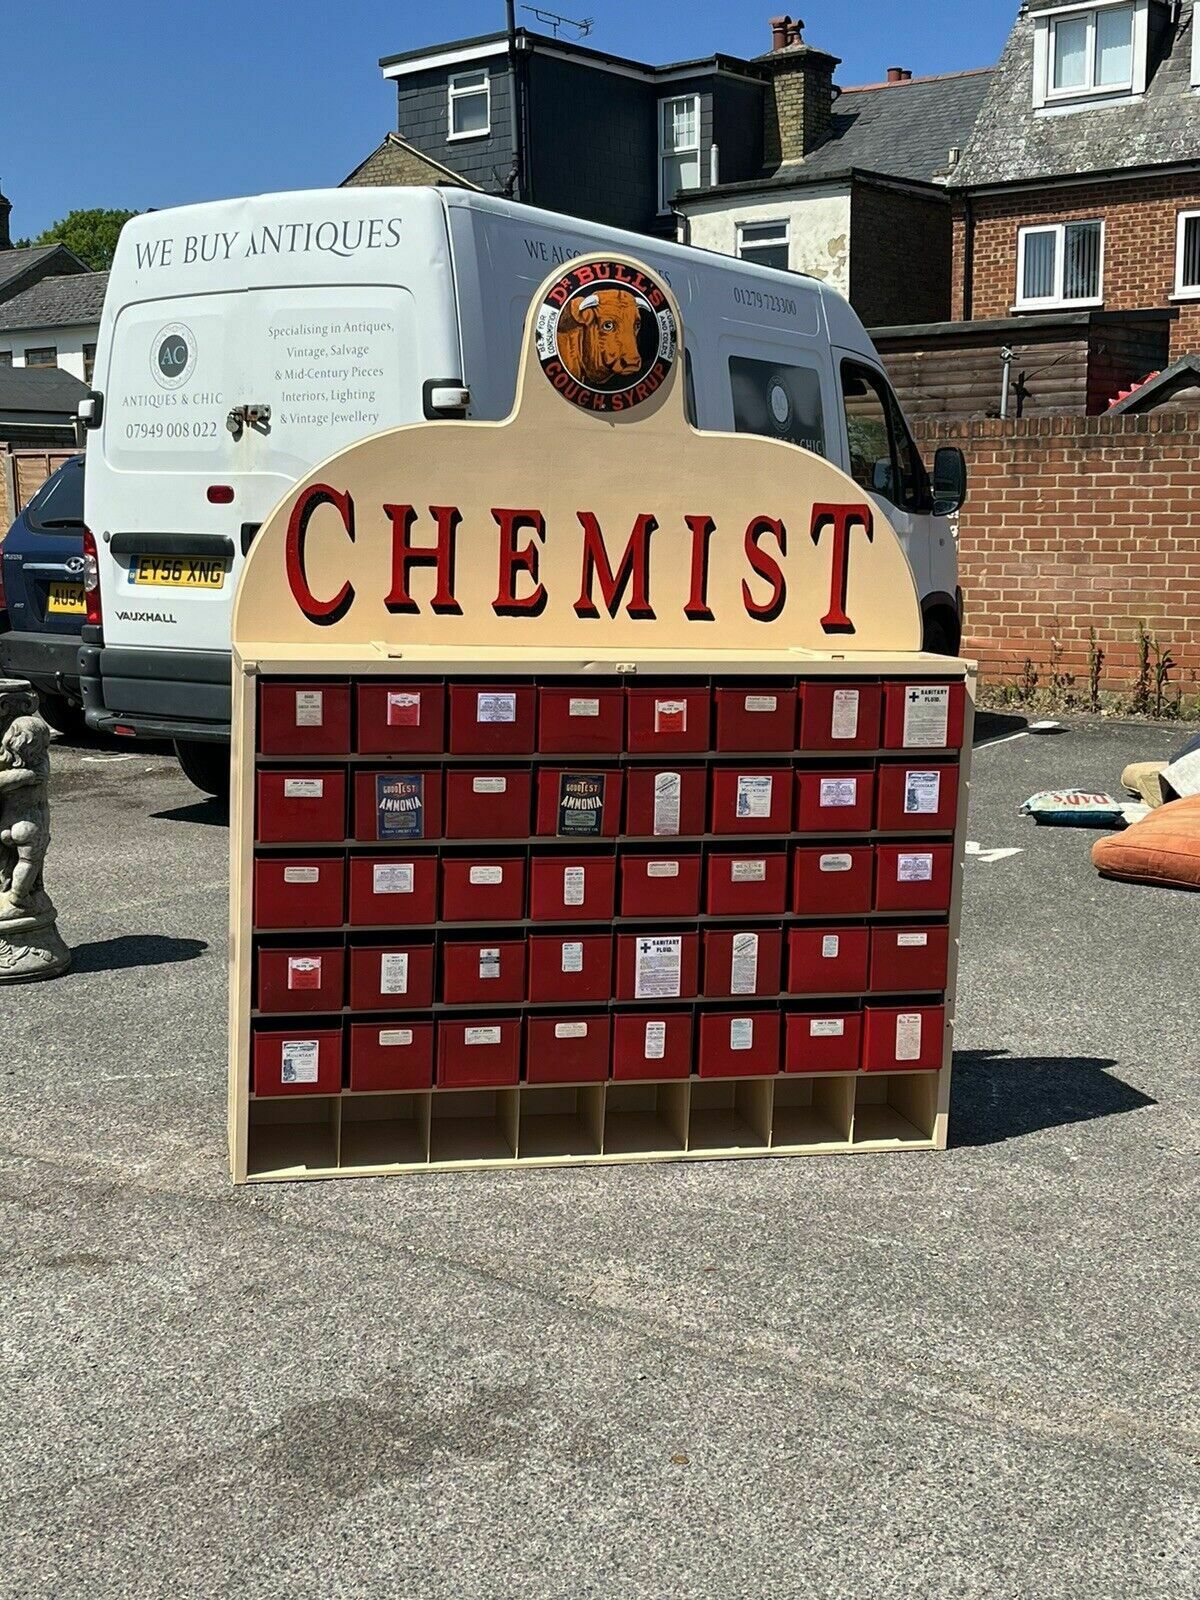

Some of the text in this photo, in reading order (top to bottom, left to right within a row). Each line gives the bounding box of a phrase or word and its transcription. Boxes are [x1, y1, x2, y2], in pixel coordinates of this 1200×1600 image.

[136, 218, 402, 269] WE BUY ANTIQUES
[524, 239, 548, 261] WE
[573, 262, 665, 308] BULL'S
[733, 287, 763, 309] 01279
[268, 322, 395, 340] Specialising in Antiques,
[660, 316, 669, 355] AND COLDS
[161, 345, 186, 365] AC
[287, 344, 369, 360] Vintage, Salvage
[274, 367, 384, 381] & Mid-Century Pieces
[546, 362, 665, 411] COUGH SYRUP
[122, 392, 223, 408] ANTIQUES & CHIC
[282, 389, 376, 403] Interiors, Lighting
[280, 411, 379, 426] & Vintage Jewellery
[126, 422, 217, 439] 07949 008 022
[285, 482, 874, 634] CHEMIST
[139, 559, 222, 583] EY56 XNG
[54, 589, 85, 607] AU54
[115, 611, 177, 623] VAUXHALL
[379, 796, 422, 812] AMMONIA
[561, 796, 603, 810] AMMONIA
